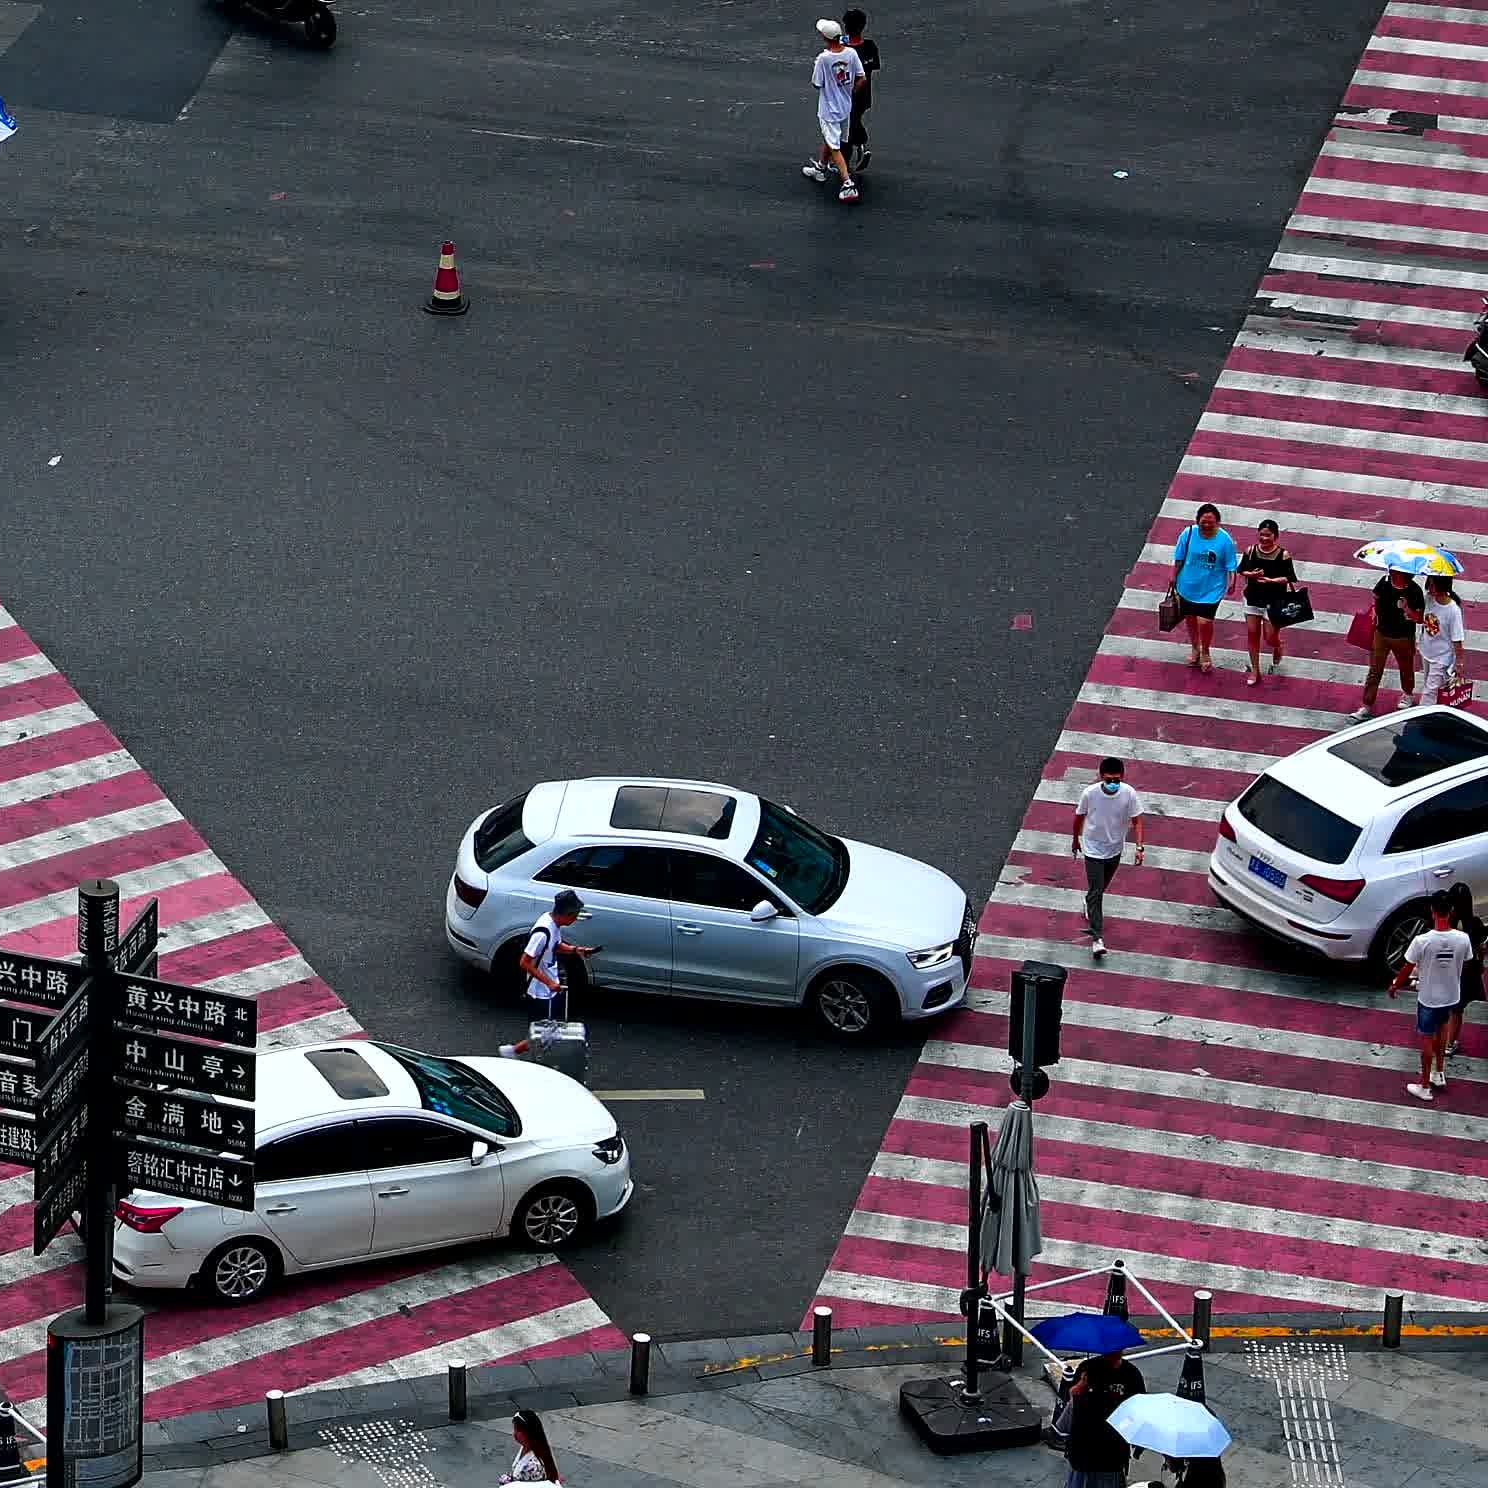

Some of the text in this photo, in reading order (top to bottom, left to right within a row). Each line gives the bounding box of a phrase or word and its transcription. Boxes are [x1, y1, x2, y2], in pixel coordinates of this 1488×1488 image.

[103, 898, 117, 952] 芙蓉区
[126, 985, 249, 1026] 黄兴中路 北
[126, 1040, 224, 1079] 中山亭
[125, 1095, 223, 1135] 金满地
[1112, 1295, 1125, 1304] IFS
[977, 1327, 990, 1338] IFS
[1190, 1381, 1202, 1390] IFS
